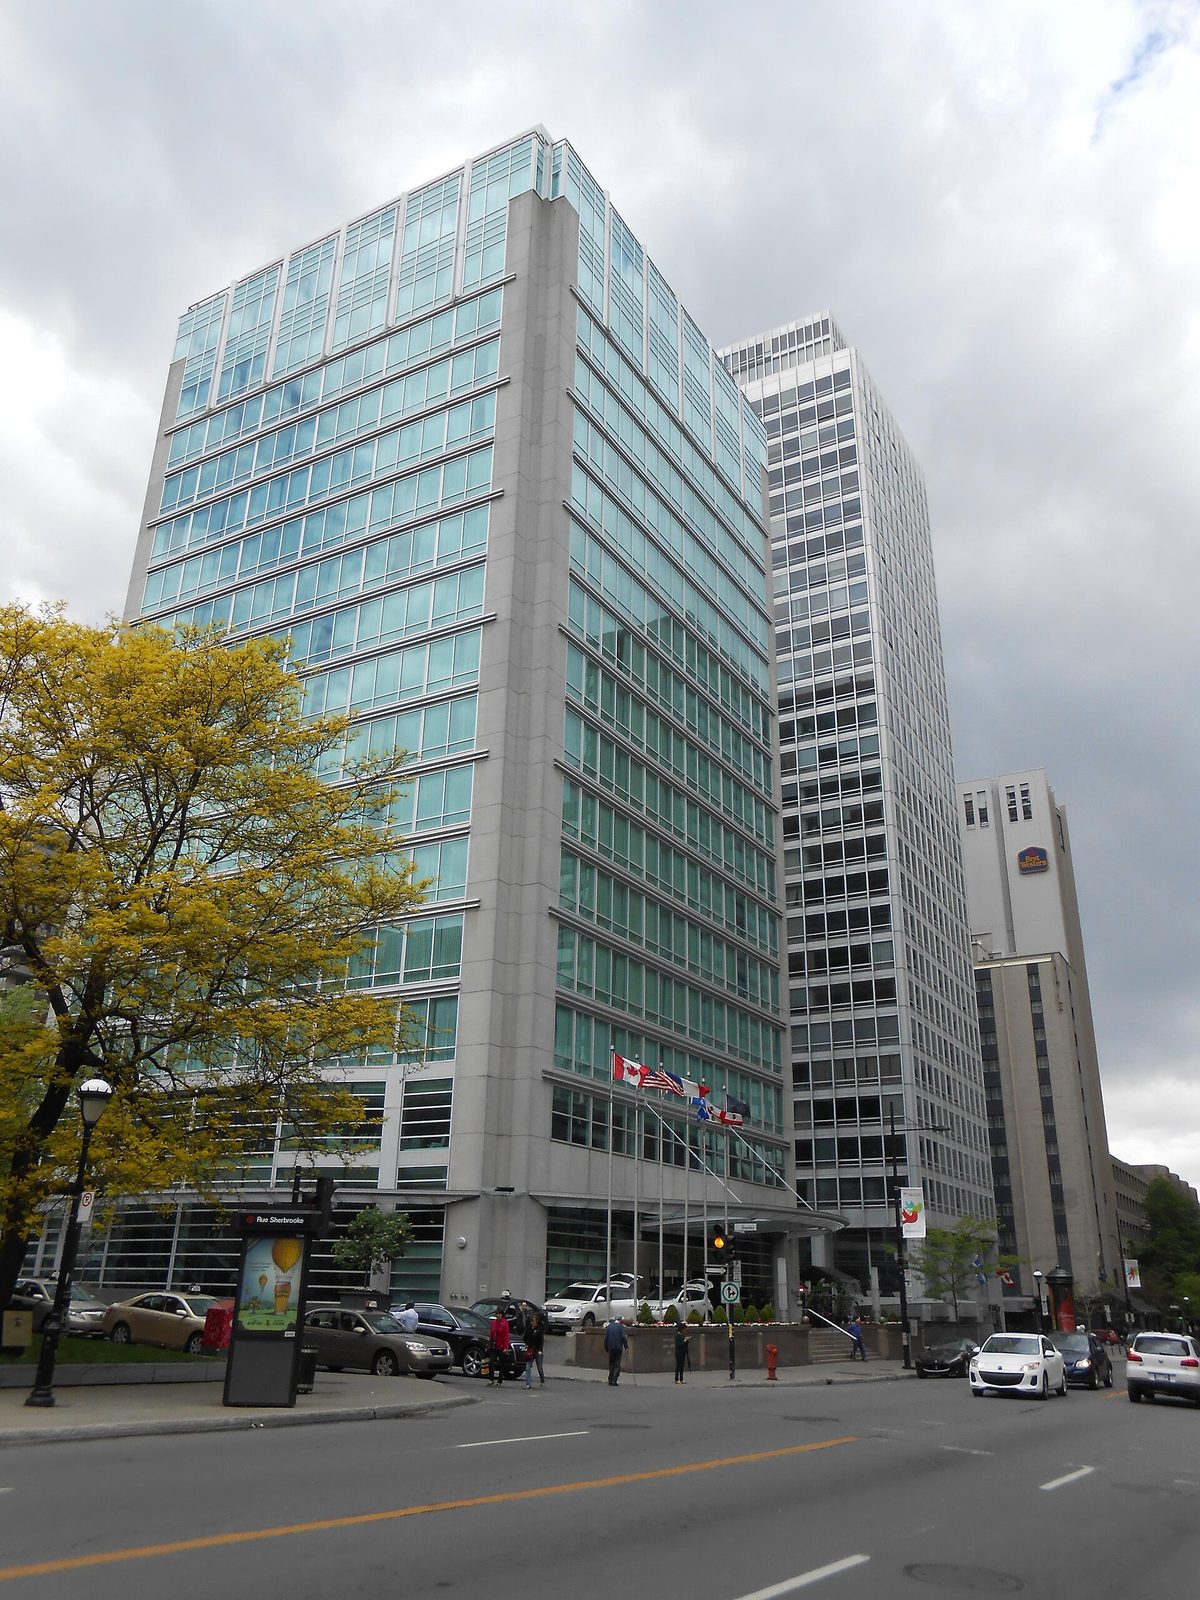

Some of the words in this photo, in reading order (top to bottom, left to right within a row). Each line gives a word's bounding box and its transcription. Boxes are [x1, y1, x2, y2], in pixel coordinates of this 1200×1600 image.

[1025, 855, 1040, 863] Best
[1020, 860, 1047, 868] Western
[269, 1216, 304, 1224] Sherbrooke
